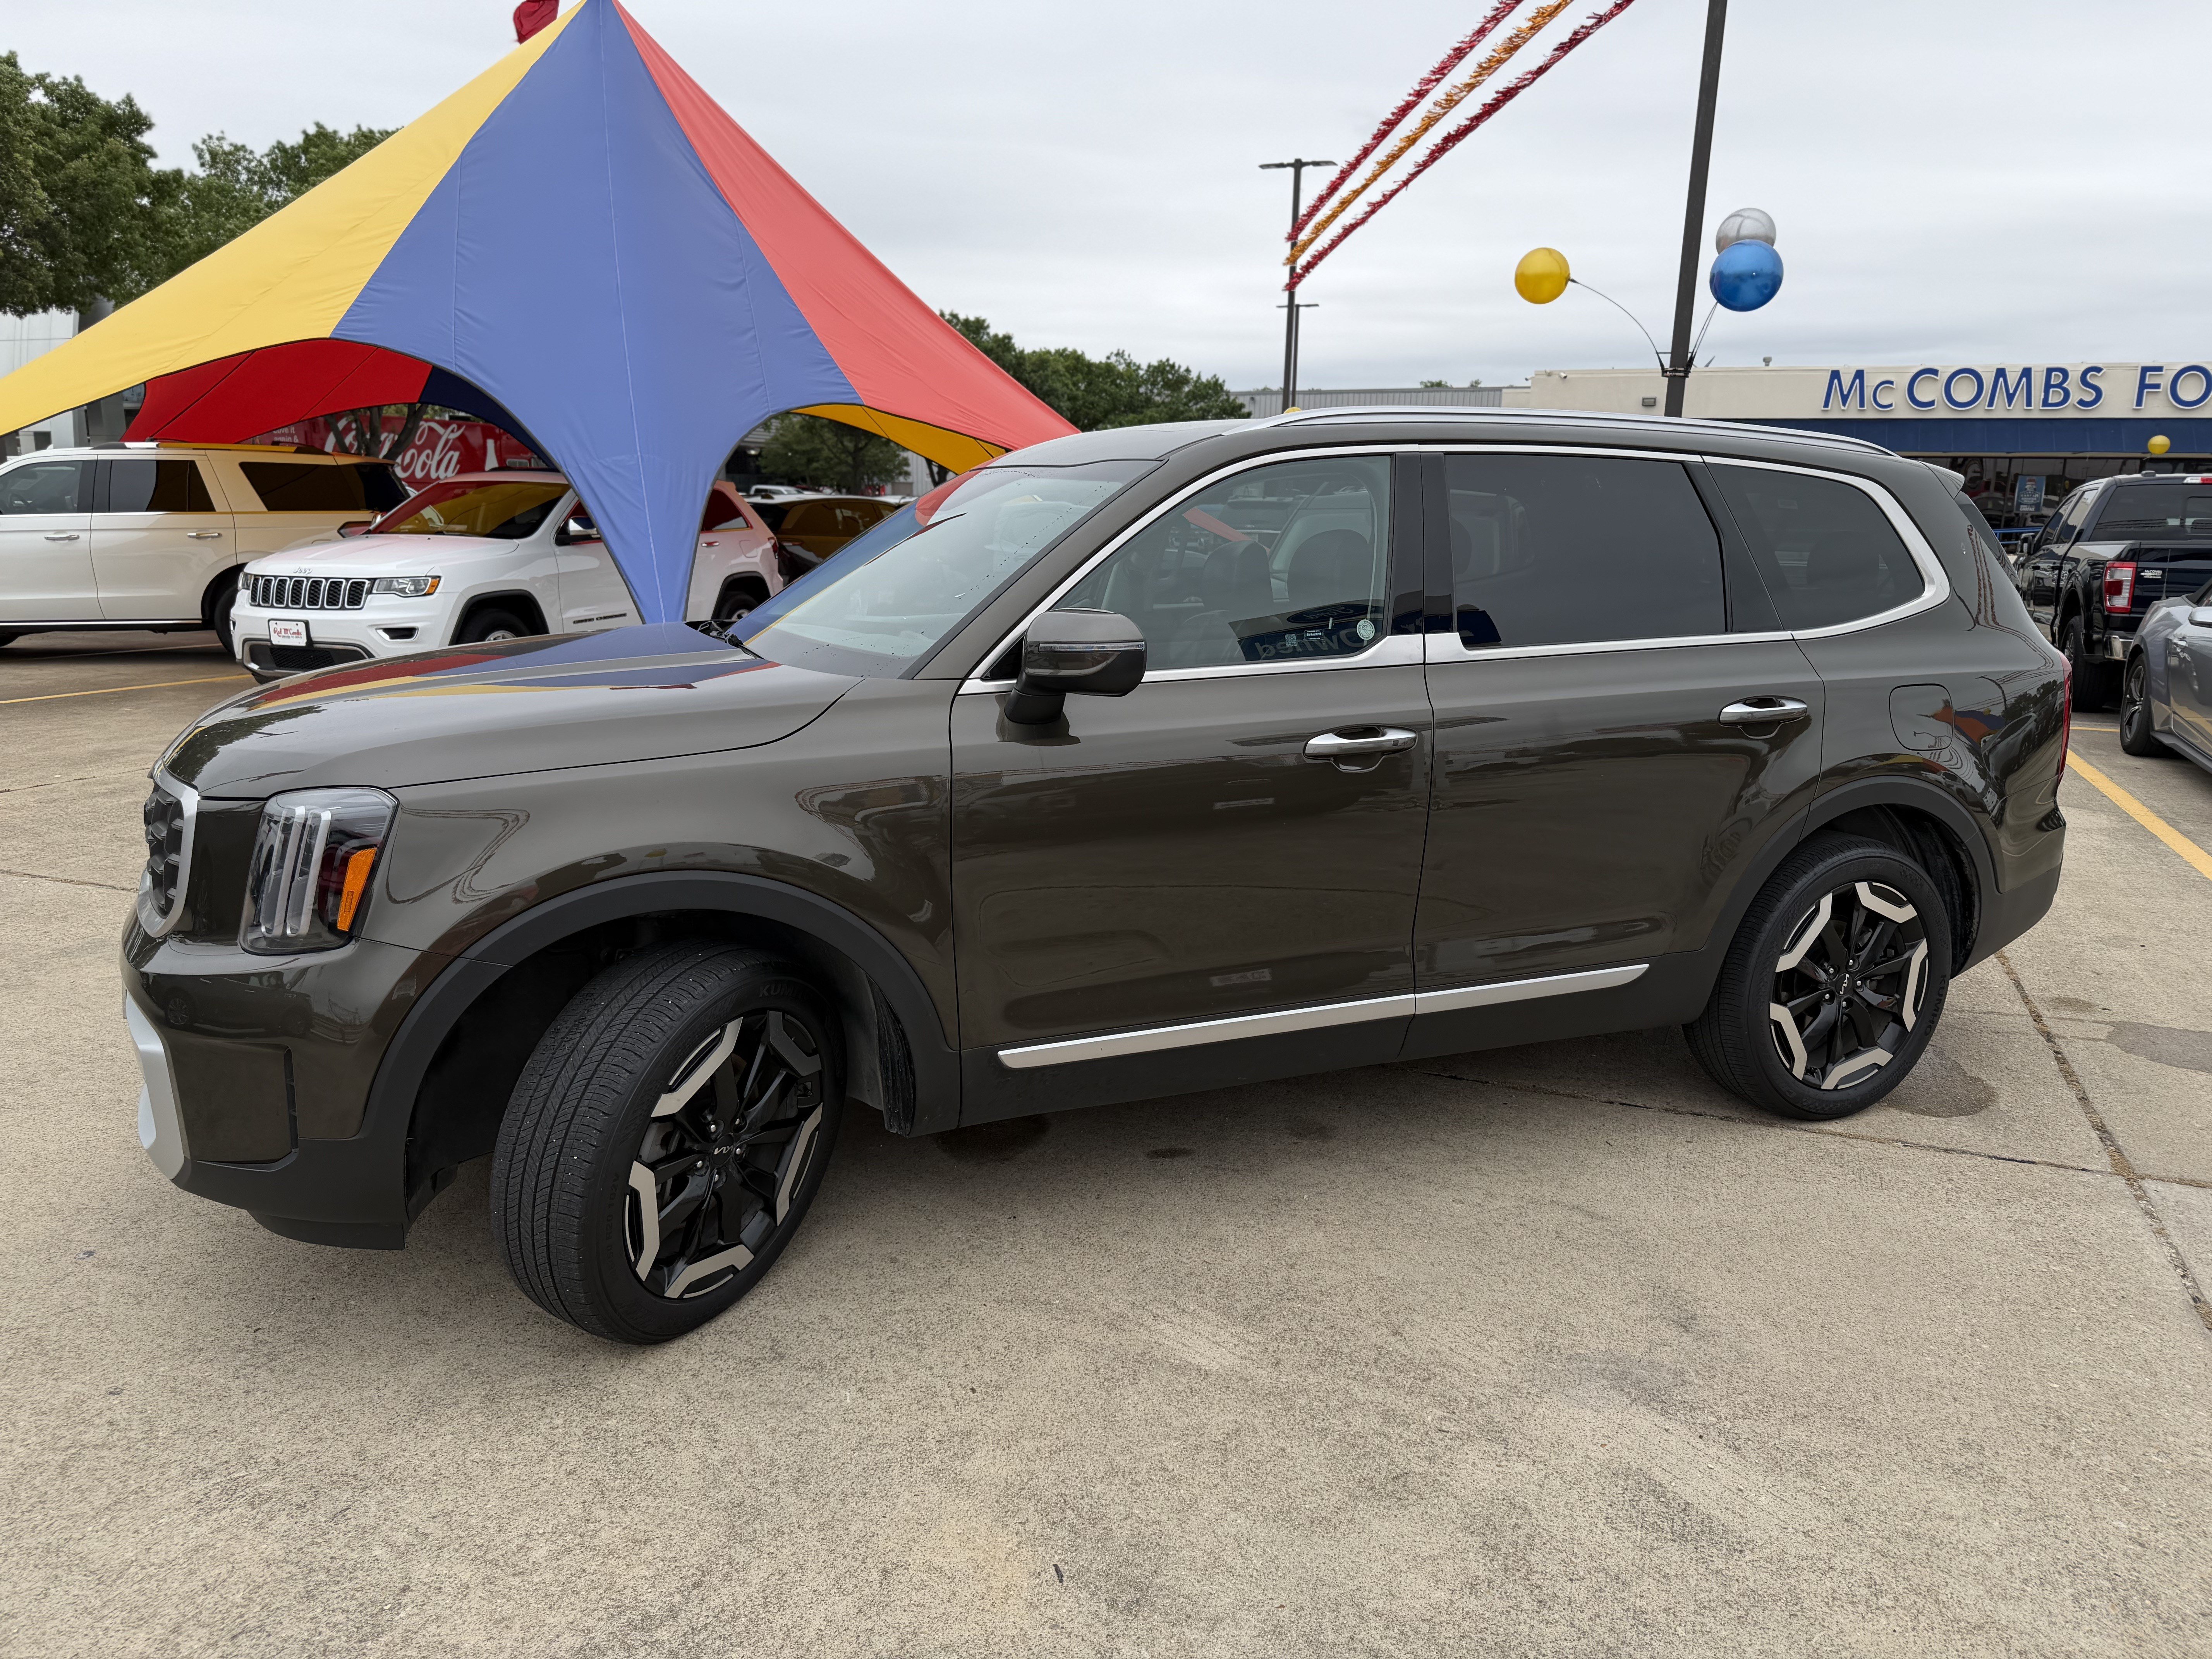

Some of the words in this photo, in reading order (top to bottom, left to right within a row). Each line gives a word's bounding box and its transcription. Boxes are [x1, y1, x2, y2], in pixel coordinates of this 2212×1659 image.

[1821, 365, 2106, 411] McCOMBS
[292, 566, 313, 575] Jeep
[1924, 974, 1947, 1036] KUMHO
